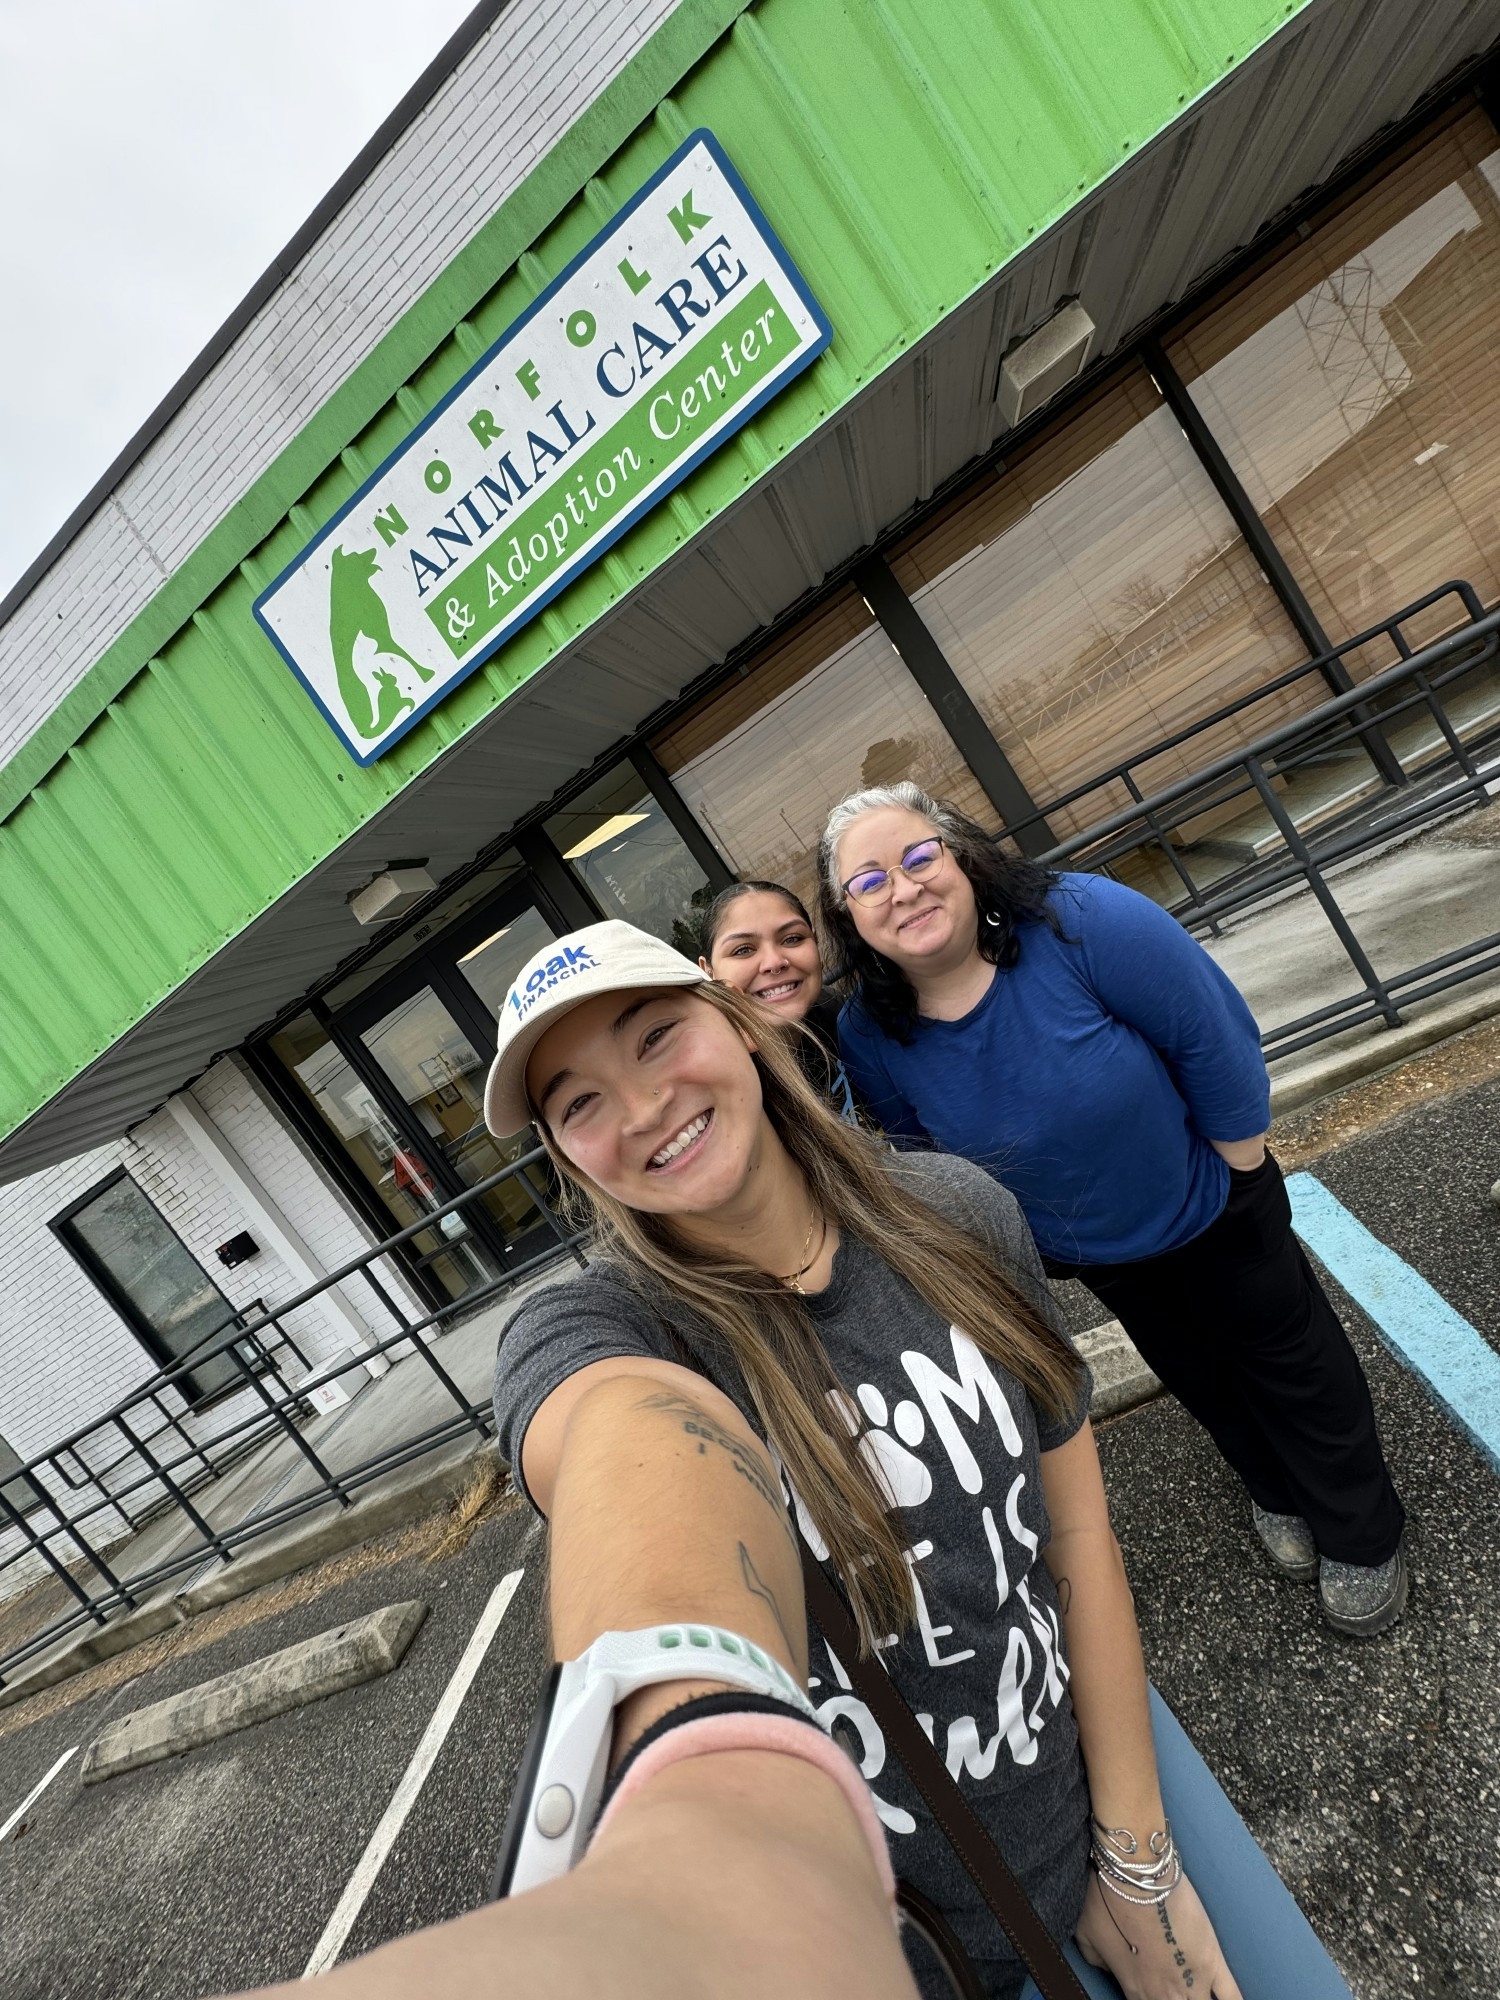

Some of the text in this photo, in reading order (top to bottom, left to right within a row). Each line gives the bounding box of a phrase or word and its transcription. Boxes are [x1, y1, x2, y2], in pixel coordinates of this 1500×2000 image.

[372, 189, 714, 547] NORFOLK
[403, 235, 749, 597] ANIMAL CARE
[443, 306, 776, 639] & Adoption Center
[519, 960, 601, 1021] FINANCIAL
